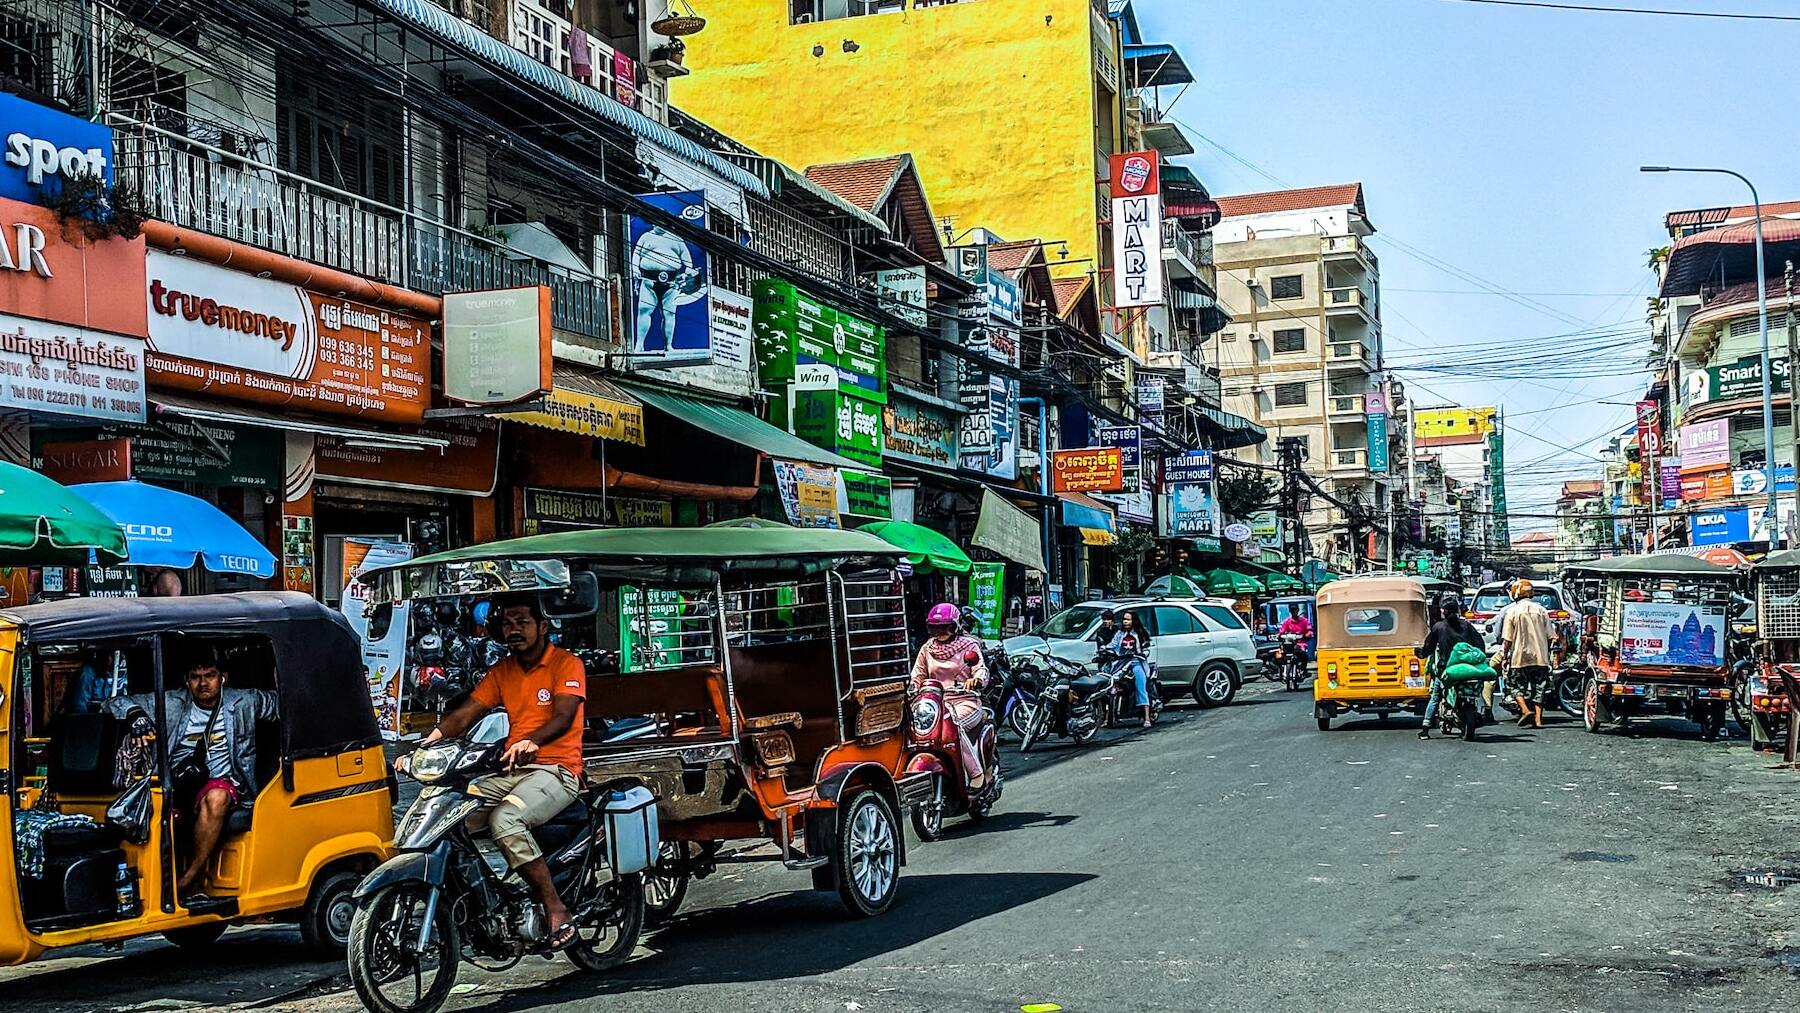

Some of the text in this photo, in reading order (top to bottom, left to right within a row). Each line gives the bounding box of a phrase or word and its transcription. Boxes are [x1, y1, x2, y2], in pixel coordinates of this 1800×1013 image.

[6, 132, 107, 185] spot
[1123, 198, 1148, 300] MART
[149, 280, 296, 351] truemoney
[320, 336, 373, 359] 099 636 345
[320, 349, 374, 371] 093 366 345
[54, 369, 100, 388] PHONE
[106, 376, 140, 393] SHOP
[800, 373, 829, 386] Wing
[1719, 363, 1761, 382] Smart
[51, 448, 120, 470] SUGAR
[1165, 450, 1210, 471] ផ្ទះសំណាក់
[1165, 470, 1211, 481] GUEST HOUSE
[1176, 511, 1209, 519] SUNFLOWER
[1178, 520, 1211, 531] MART
[1697, 514, 1727, 526] NOKIA
[220, 554, 259, 572] TECNO
